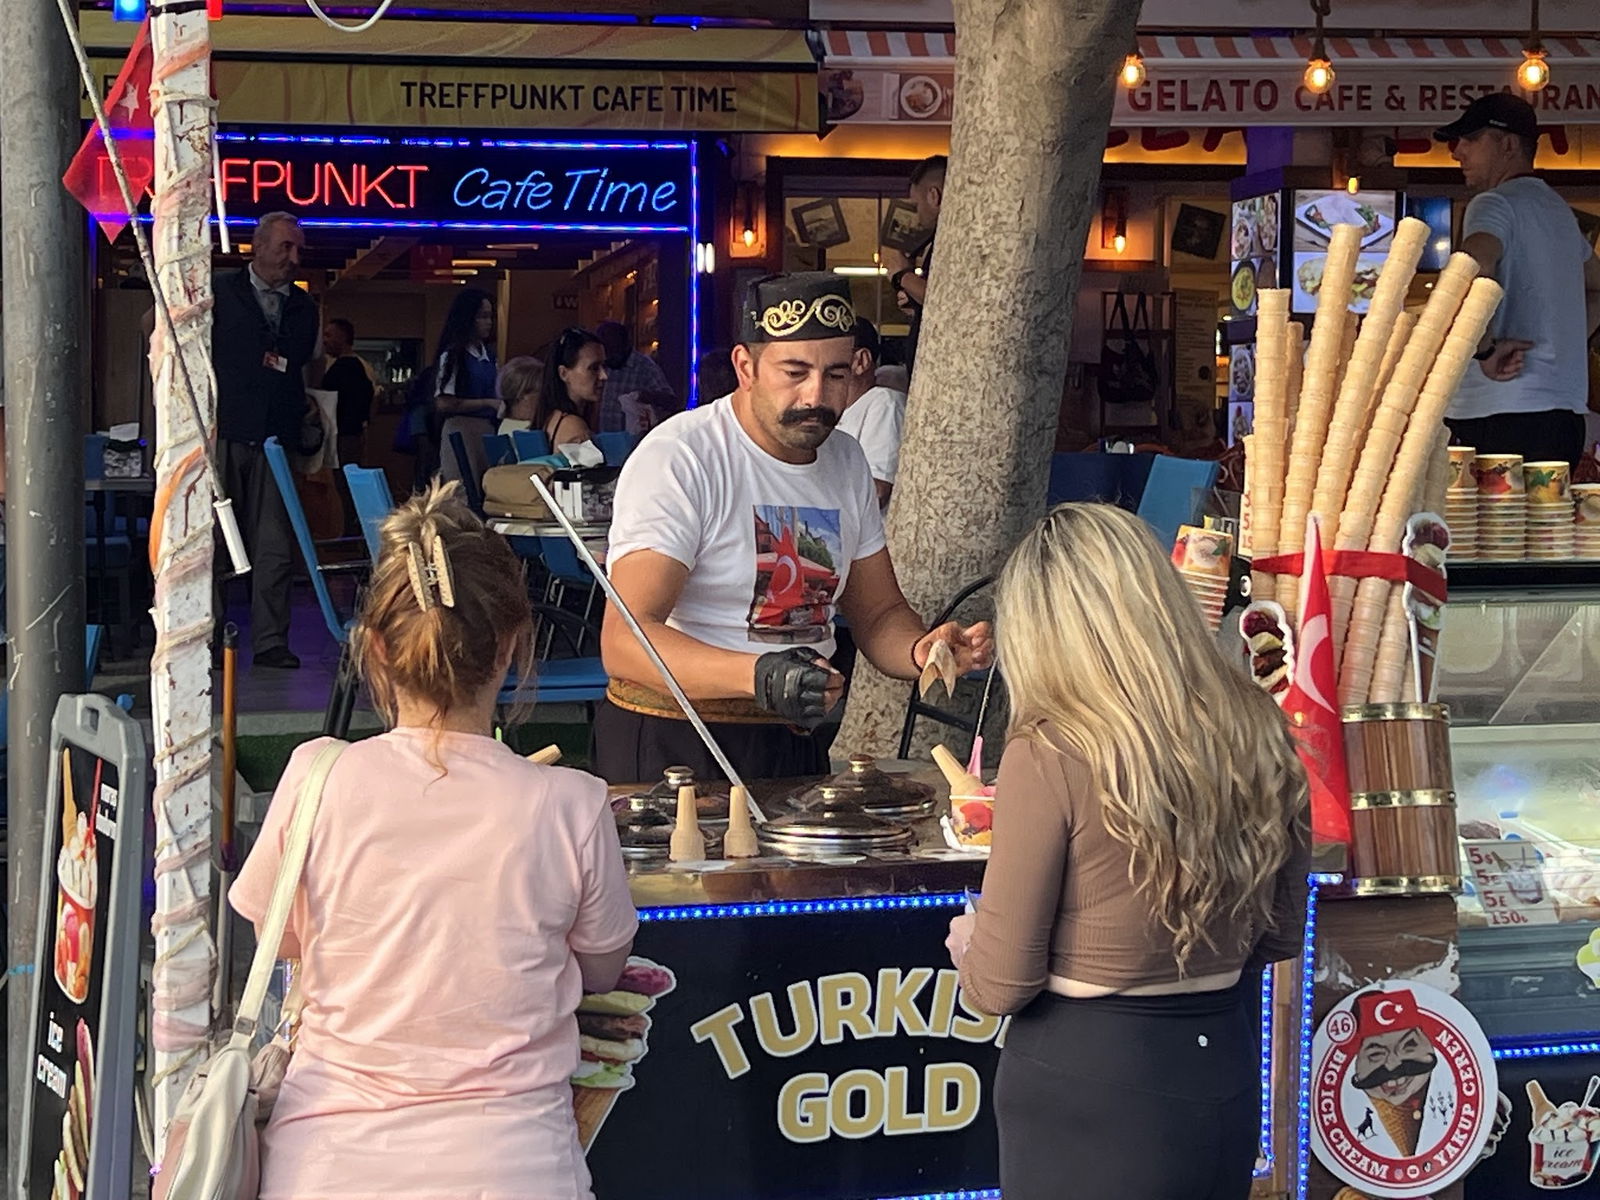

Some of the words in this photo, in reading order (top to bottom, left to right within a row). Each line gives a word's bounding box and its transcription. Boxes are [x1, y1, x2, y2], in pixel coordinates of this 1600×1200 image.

[400, 81, 585, 113] TREFFPUNKT
[592, 85, 664, 113] CAFE
[671, 86, 738, 113] TIME
[1127, 79, 1279, 112] GELATO
[1294, 85, 1373, 112] CAFE
[1384, 85, 1407, 112] &
[453, 168, 554, 211] Cafe
[565, 168, 678, 213] Time
[690, 967, 1012, 1080] TURKIS
[1329, 1017, 1352, 1037] 46
[1323, 1048, 1348, 1087] BIG
[1436, 1030, 1477, 1096] CEREN
[777, 1062, 981, 1143] GOLD
[1320, 1090, 1338, 1126] ICE
[1329, 1128, 1389, 1179] CREAM
[1434, 1103, 1476, 1167] YAKUP
